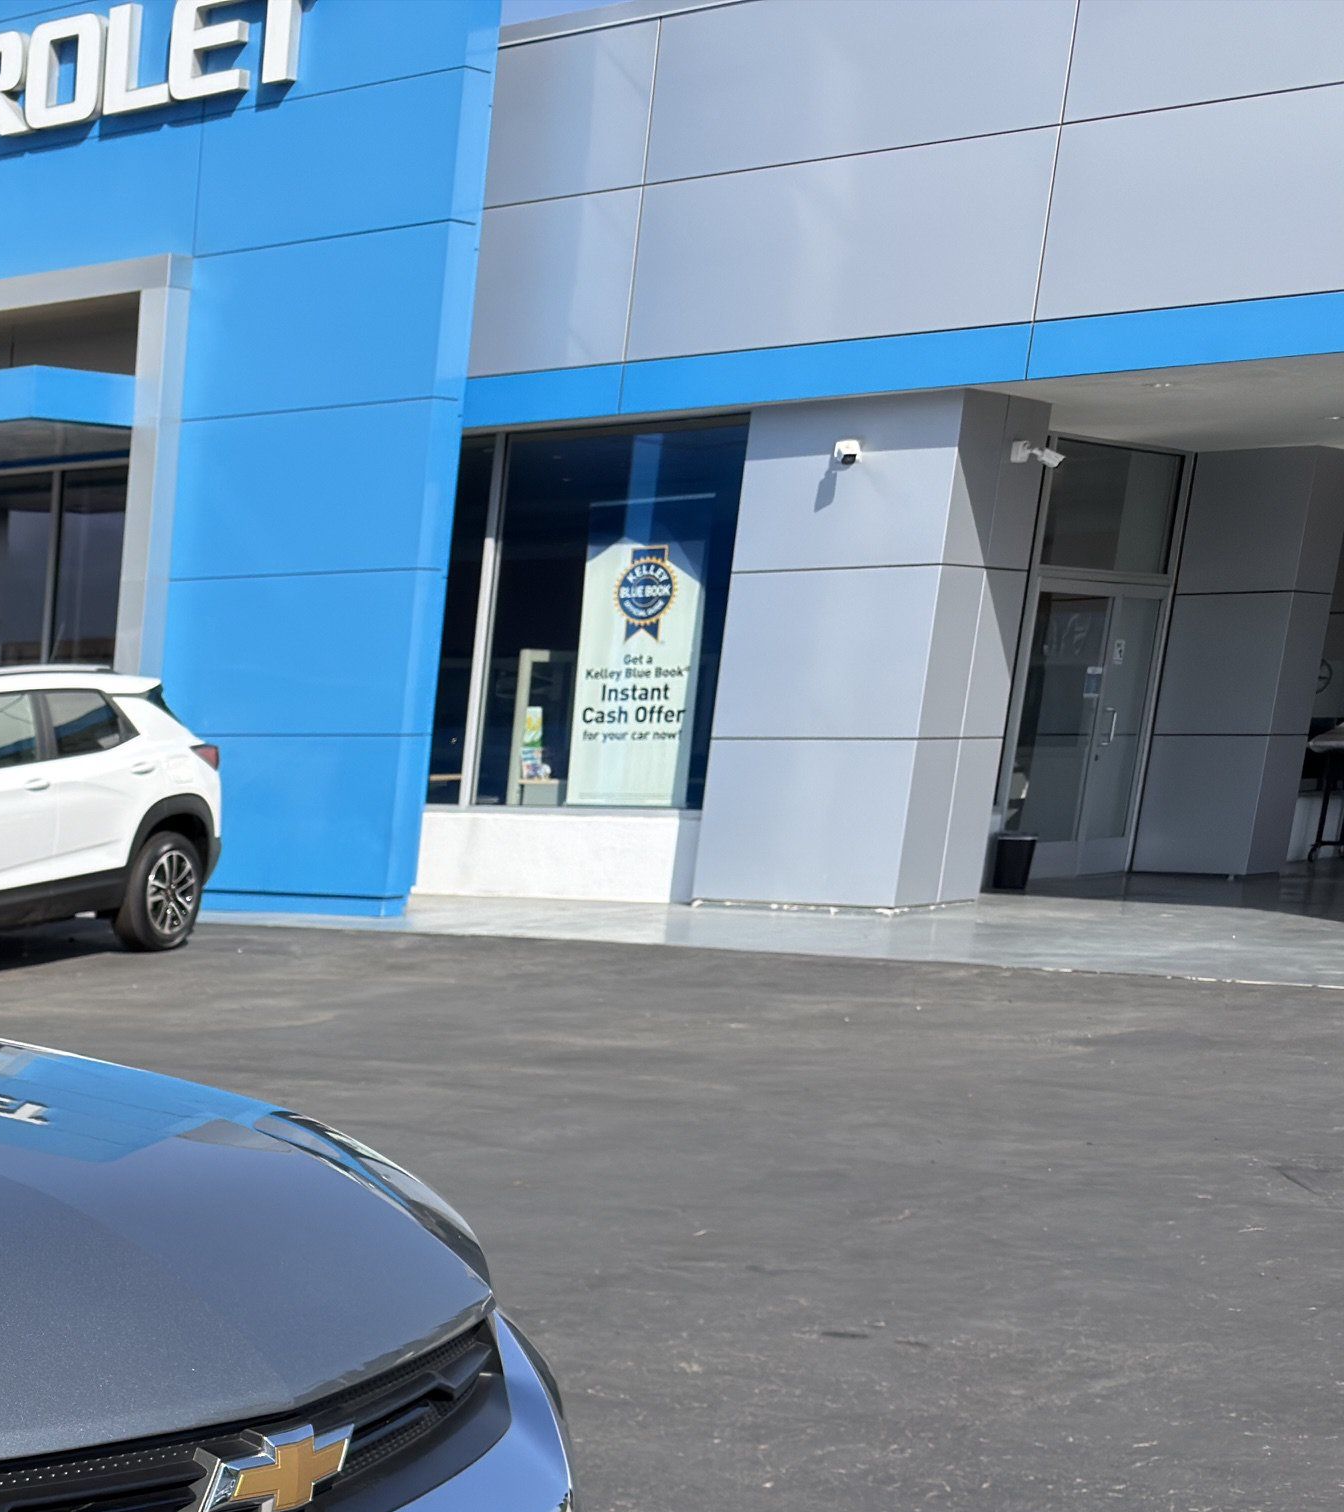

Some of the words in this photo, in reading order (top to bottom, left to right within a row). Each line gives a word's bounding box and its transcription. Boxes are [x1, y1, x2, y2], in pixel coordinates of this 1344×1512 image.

[626, 564, 670, 584] KELLEY
[619, 585, 644, 599] BLUE
[645, 583, 671, 597] BOOK
[623, 654, 643, 665] Get
[646, 656, 653, 664] a
[585, 668, 622, 681] Kelley
[625, 668, 651, 678] Blue
[601, 683, 670, 702] Instant
[582, 706, 628, 724] Cash
[635, 705, 687, 724] Offer
[583, 731, 599, 741] for
[602, 732, 628, 743] your
[631, 732, 651, 740] car
